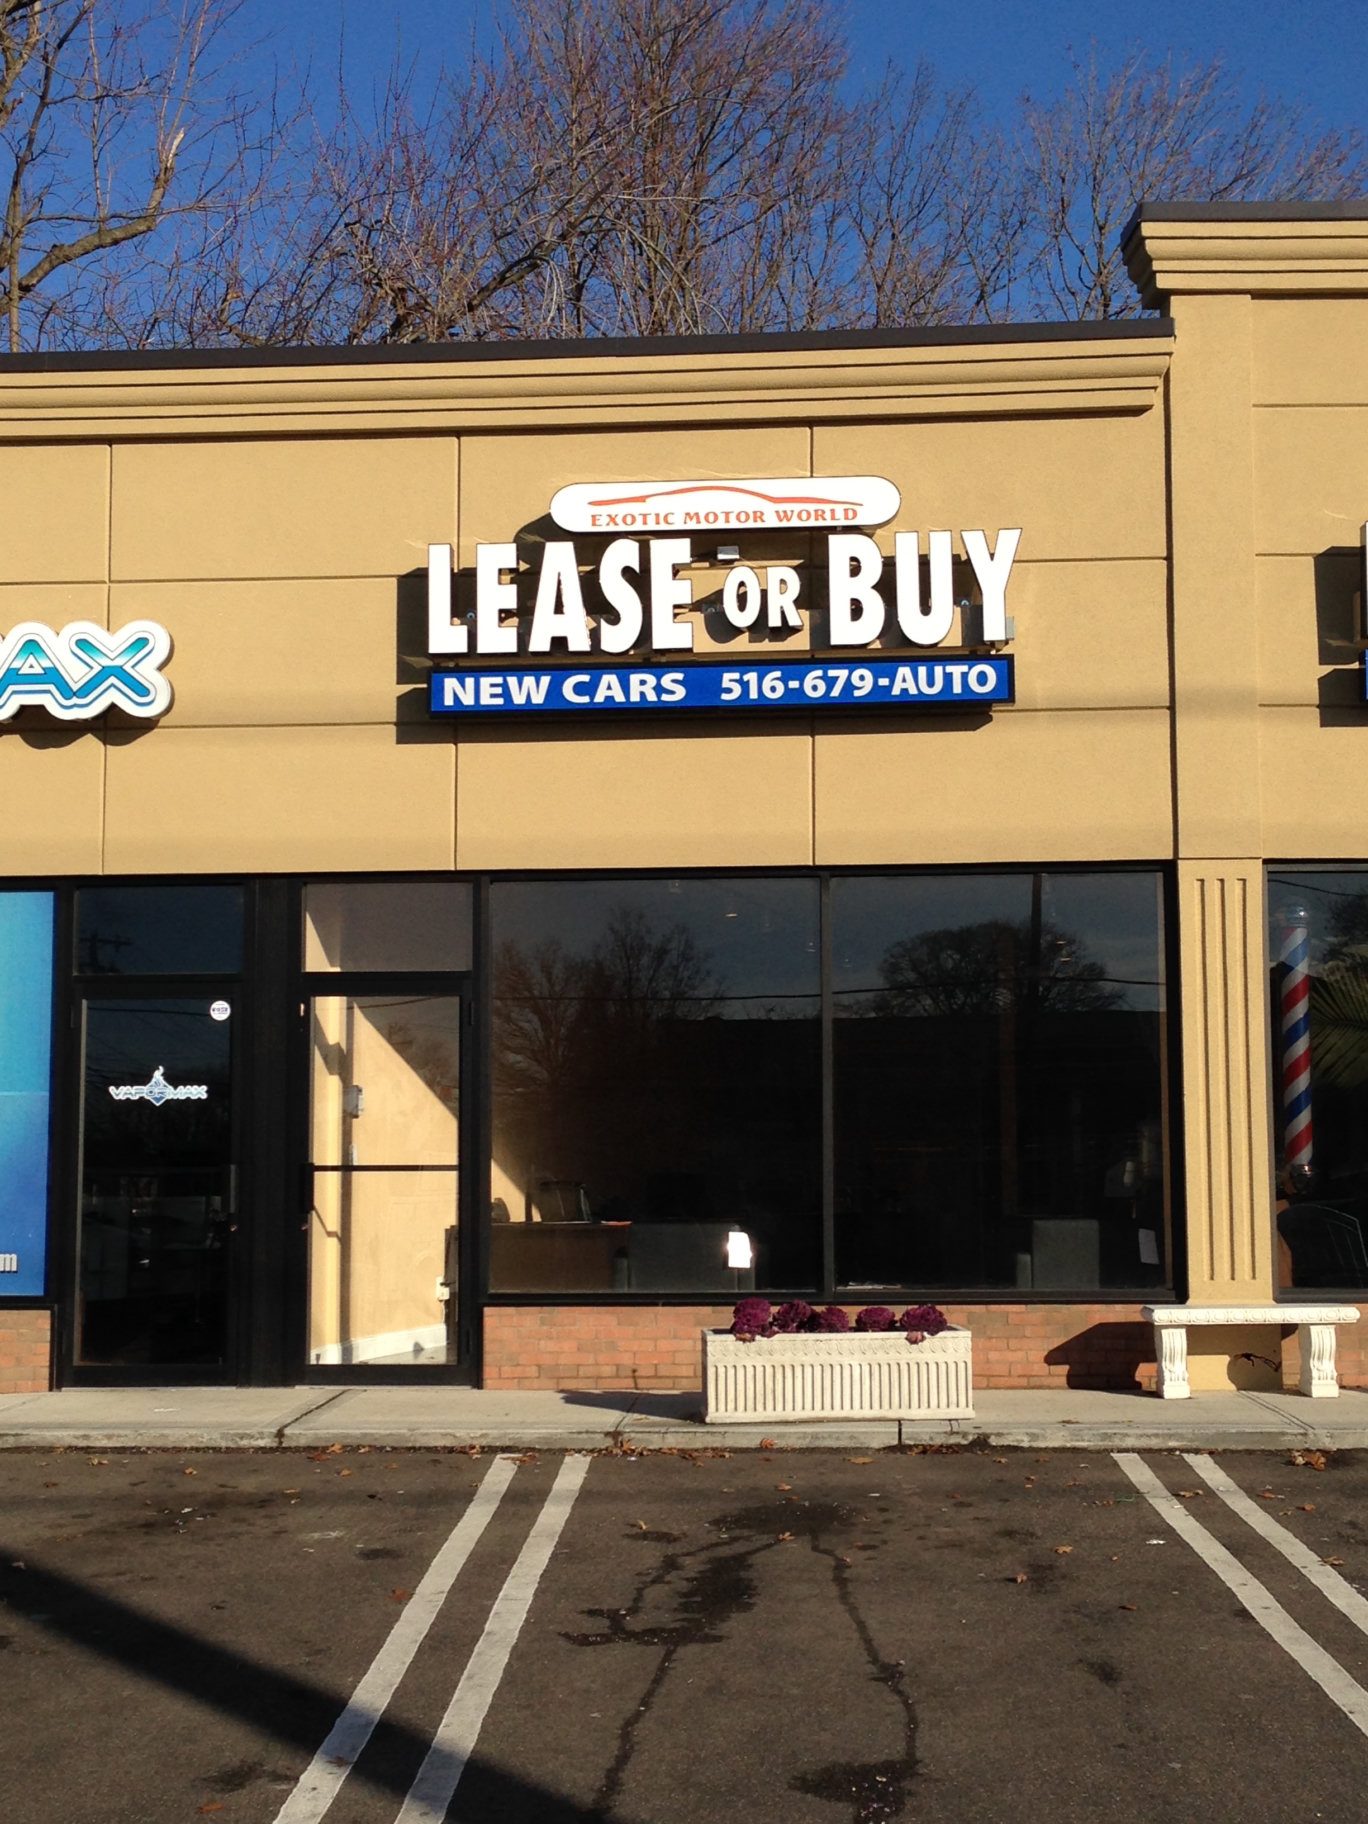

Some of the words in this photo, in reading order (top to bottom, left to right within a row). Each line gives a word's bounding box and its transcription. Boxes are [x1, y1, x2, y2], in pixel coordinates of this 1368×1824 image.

[590, 513, 676, 528] EXOTIC
[683, 510, 766, 525] MOTOR
[774, 507, 859, 523] WORLD
[428, 537, 694, 654] LEASE
[722, 565, 804, 629] OR
[827, 527, 1023, 647] BUY
[443, 675, 551, 706] NEW
[561, 672, 687, 704] CARS
[719, 664, 997, 701] 516-679-AUTO
